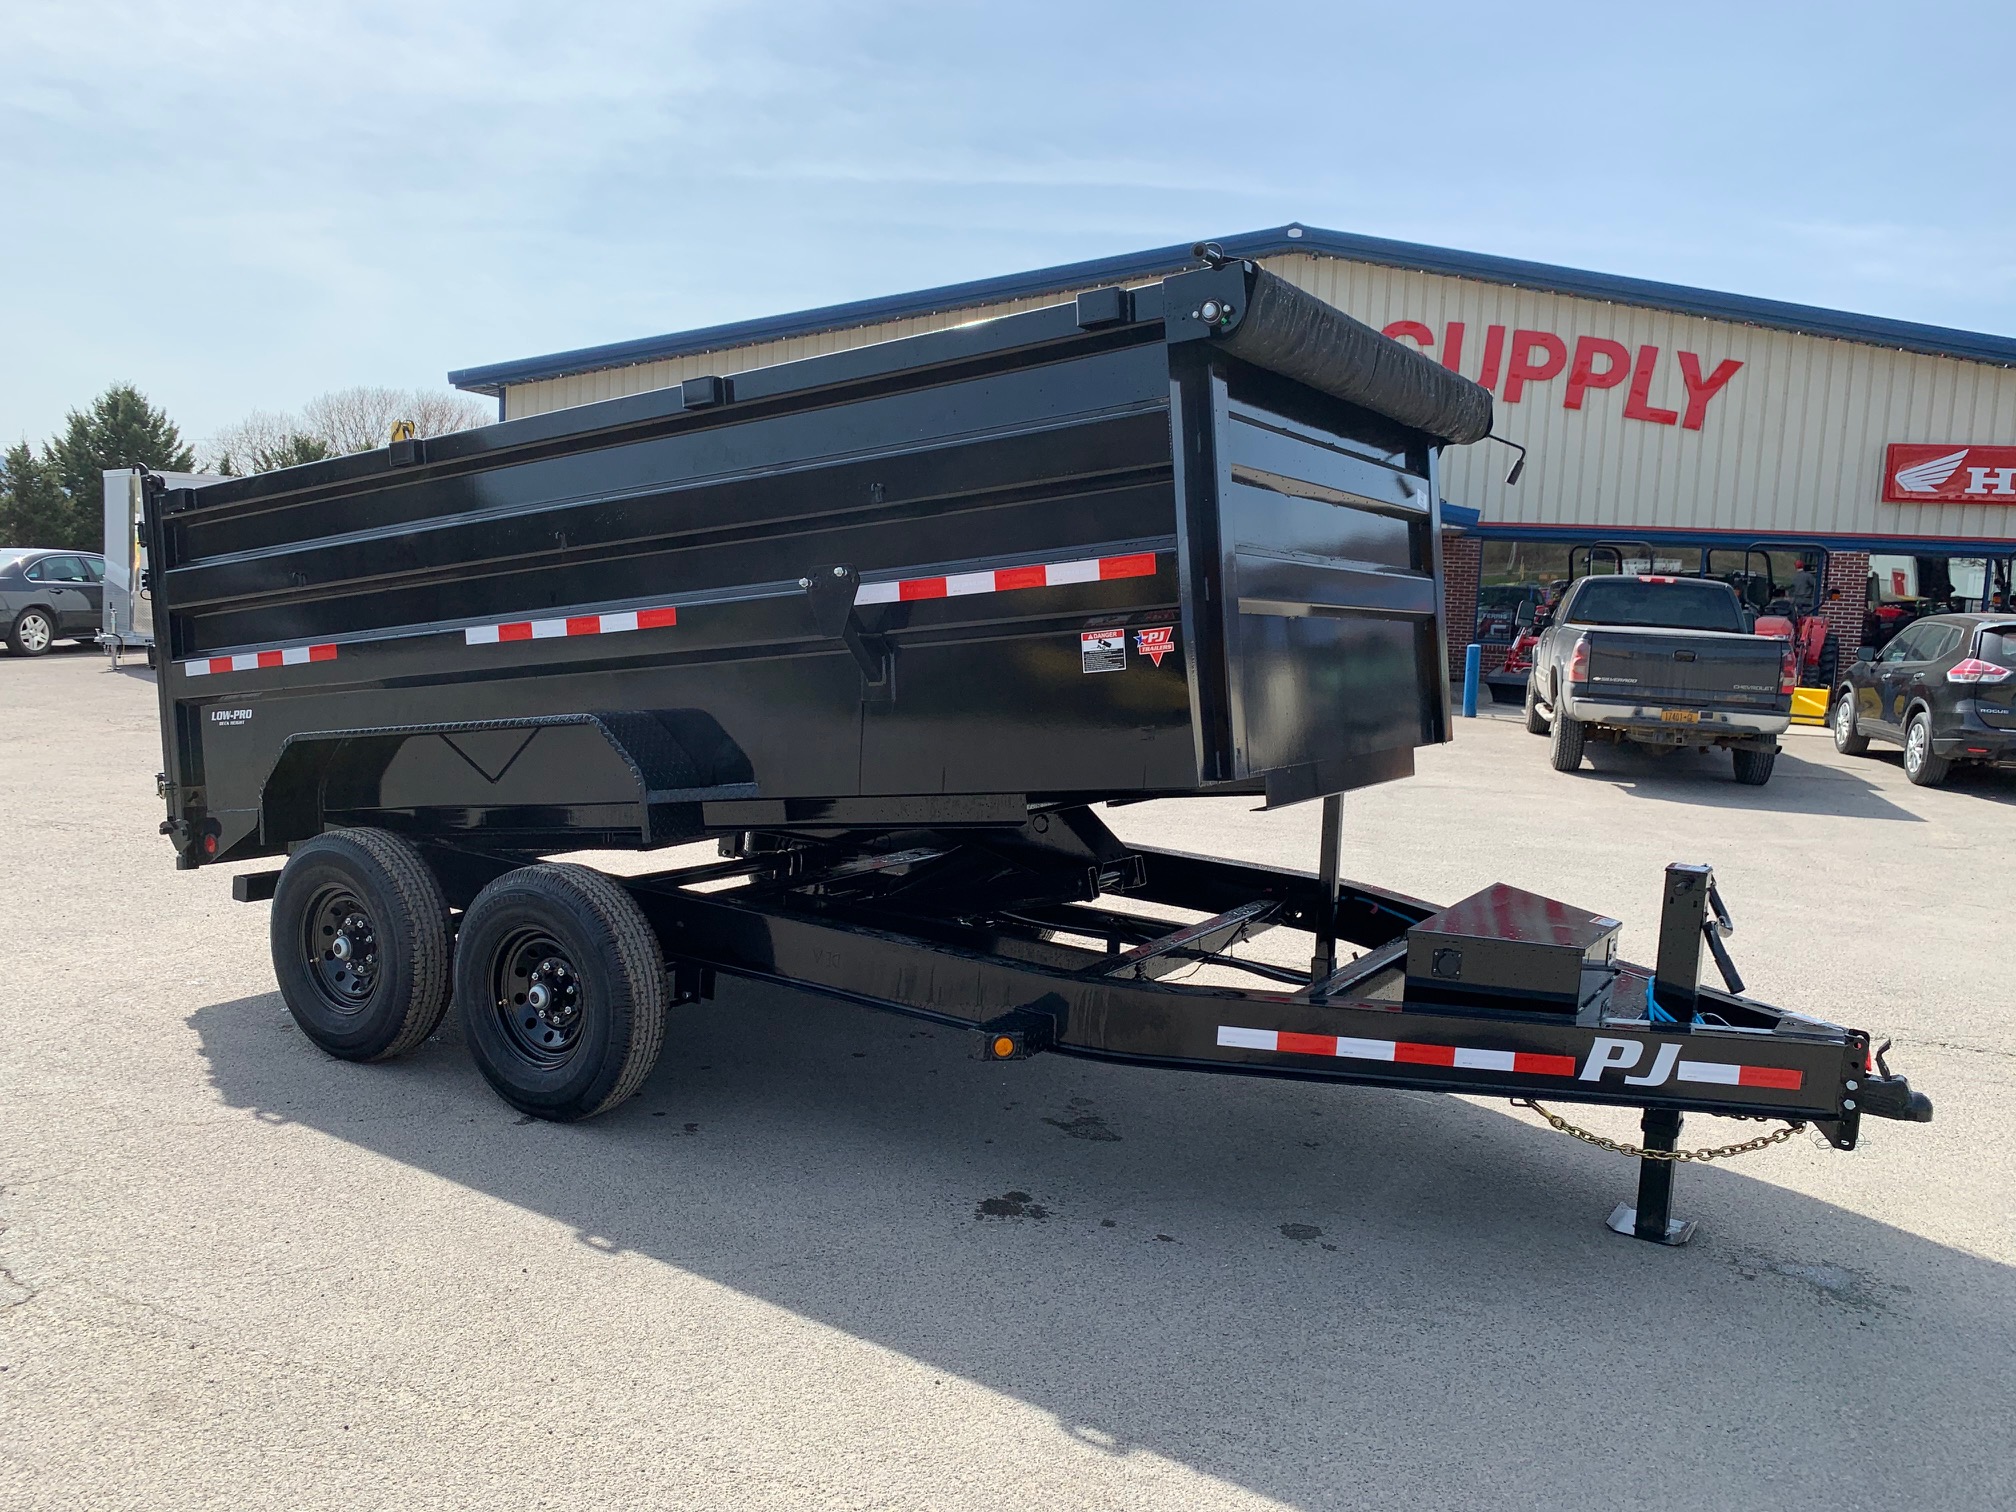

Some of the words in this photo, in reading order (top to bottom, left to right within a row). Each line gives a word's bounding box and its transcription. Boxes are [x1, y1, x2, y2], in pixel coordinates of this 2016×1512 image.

[1093, 631, 1118, 640] DANGER
[1147, 631, 1165, 643] PJ
[1141, 644, 1172, 653] TRAILERS
[1578, 1037, 1683, 1087] PJ
